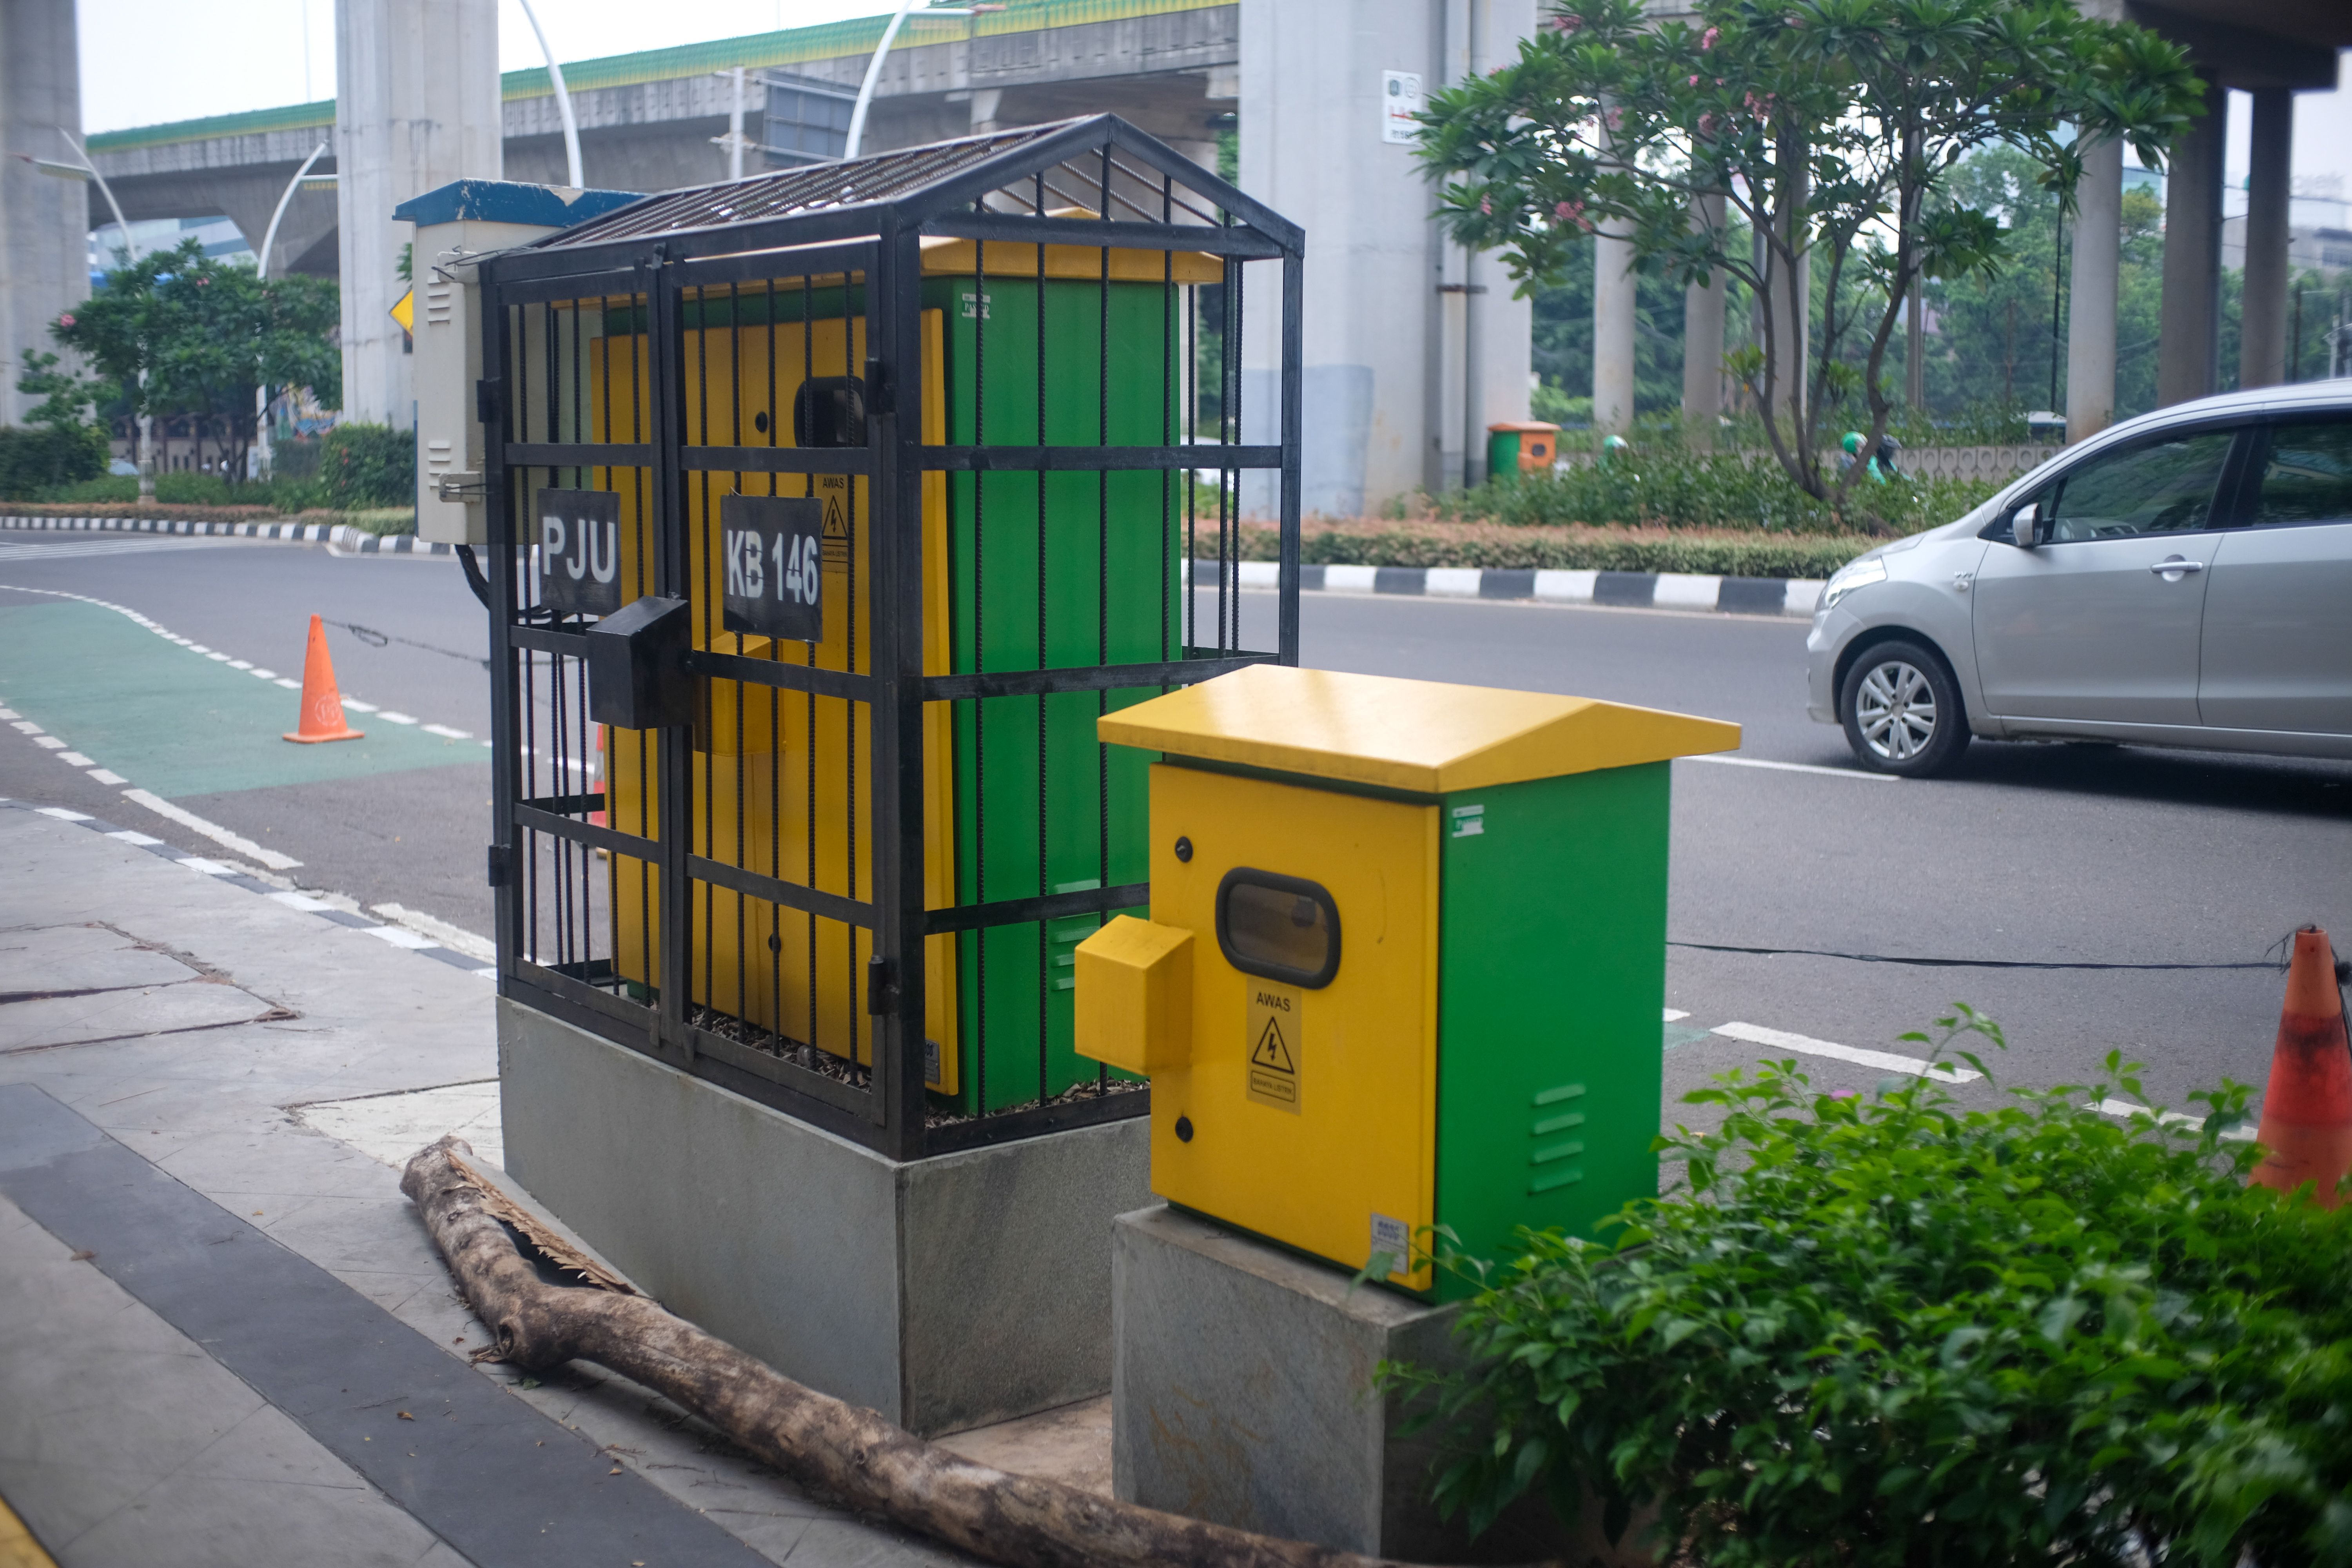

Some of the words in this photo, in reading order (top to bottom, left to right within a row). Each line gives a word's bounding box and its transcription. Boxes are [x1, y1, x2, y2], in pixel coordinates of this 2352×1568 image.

[823, 477, 844, 489] AWAS
[543, 516, 615, 583] PJU
[727, 530, 764, 598] KB
[772, 532, 818, 605] 146
[1256, 991, 1291, 1013] AWAS
